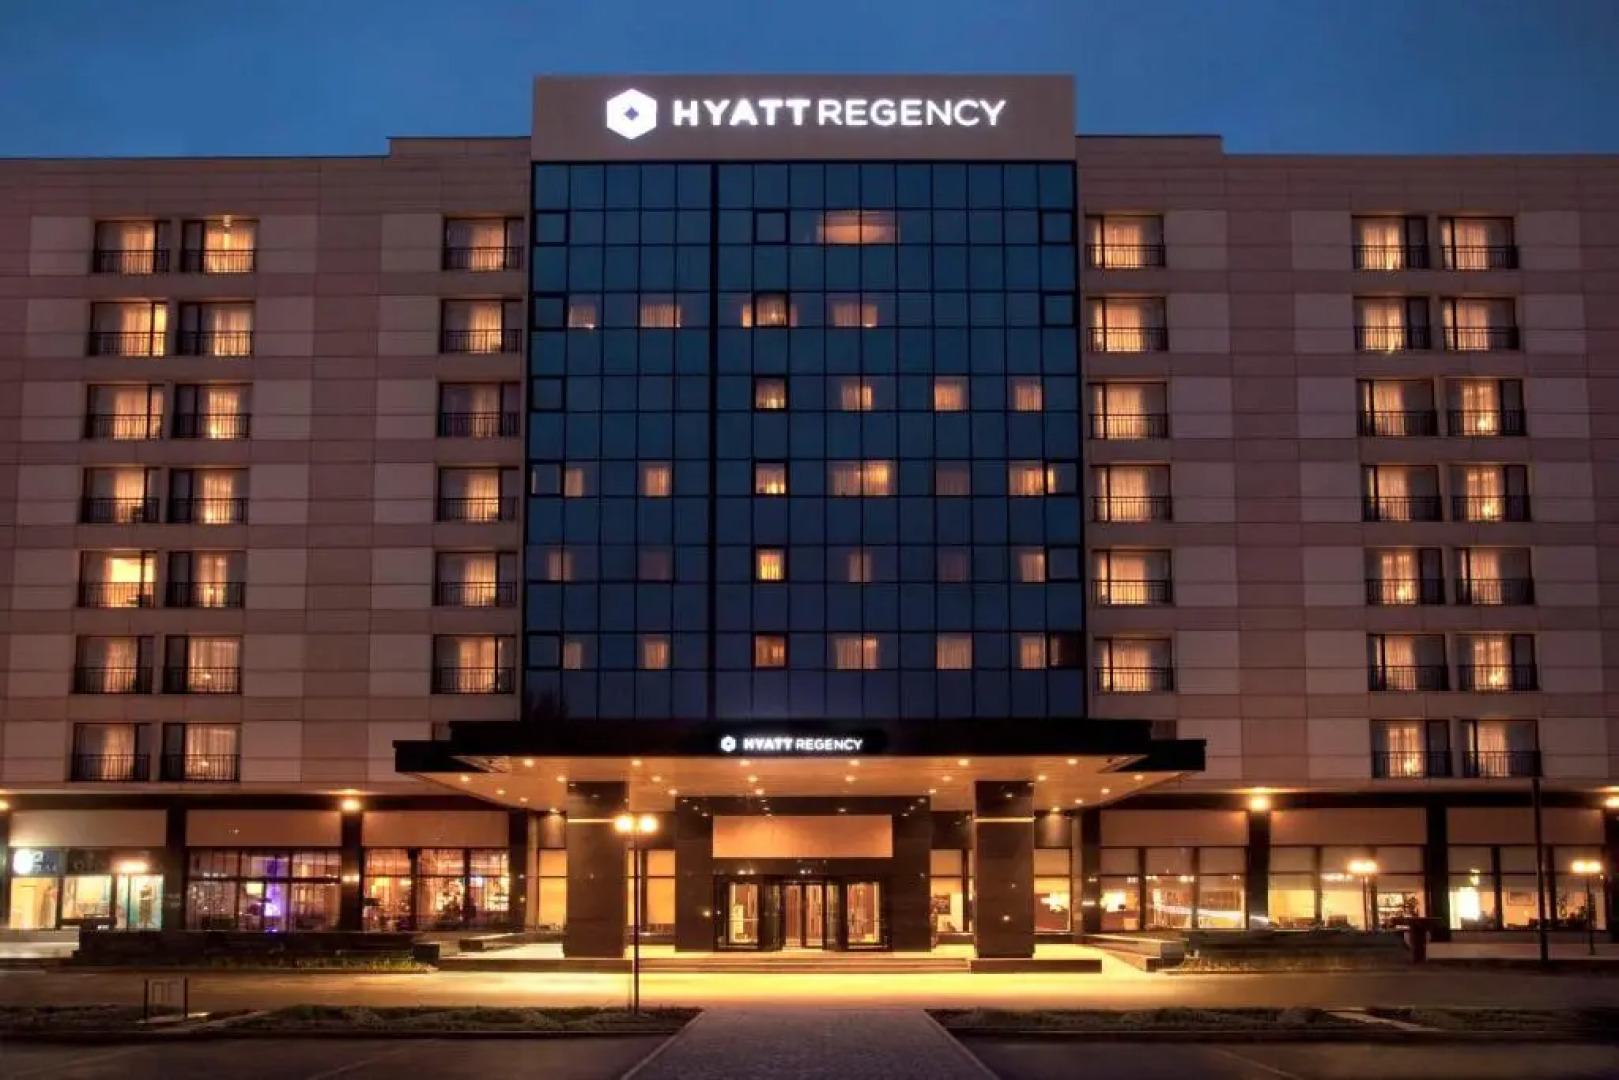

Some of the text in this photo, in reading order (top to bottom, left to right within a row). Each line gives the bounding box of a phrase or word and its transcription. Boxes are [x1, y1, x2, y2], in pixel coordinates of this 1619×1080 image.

[673, 98, 1006, 126] HYATT REGENCY
[743, 737, 863, 751] HYATT REGENCY
